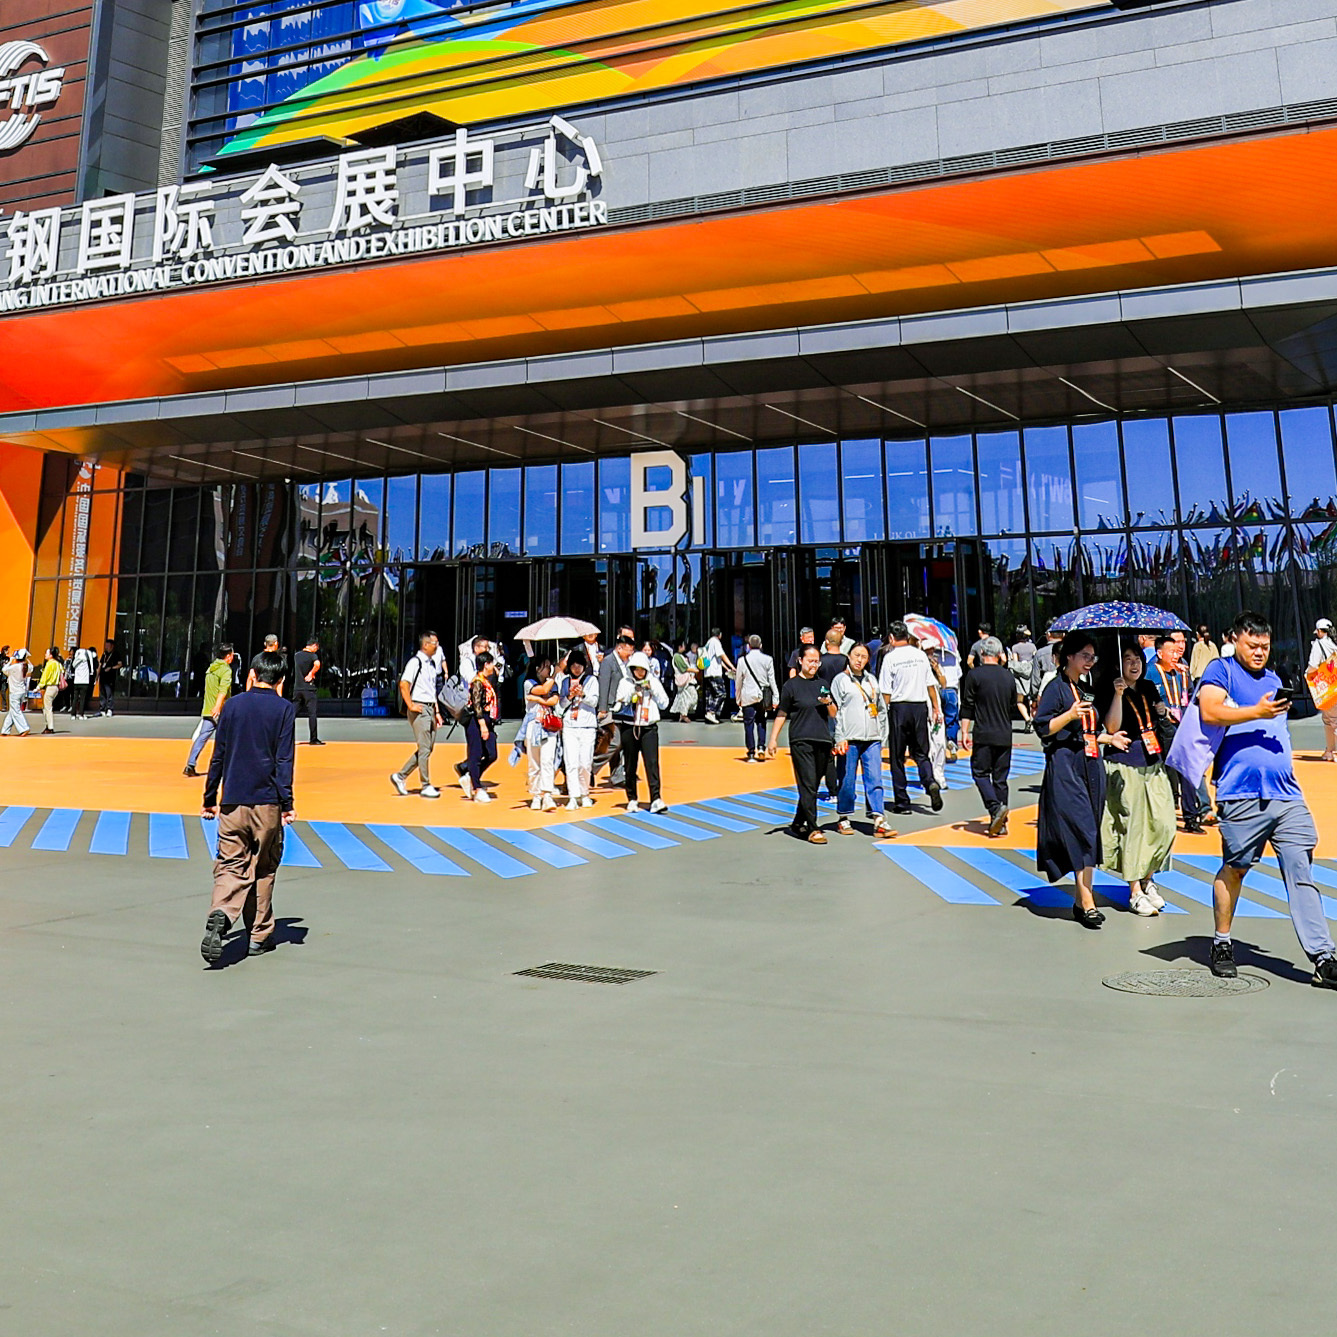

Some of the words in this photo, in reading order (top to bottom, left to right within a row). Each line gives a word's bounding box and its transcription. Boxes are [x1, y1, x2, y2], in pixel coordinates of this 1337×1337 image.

[31, 263, 174, 306] INTERNATIONAL
[180, 243, 316, 284] CONVENTION
[319, 235, 368, 266] AND
[369, 213, 506, 258] EXHIBITION
[506, 199, 608, 237] CENTER
